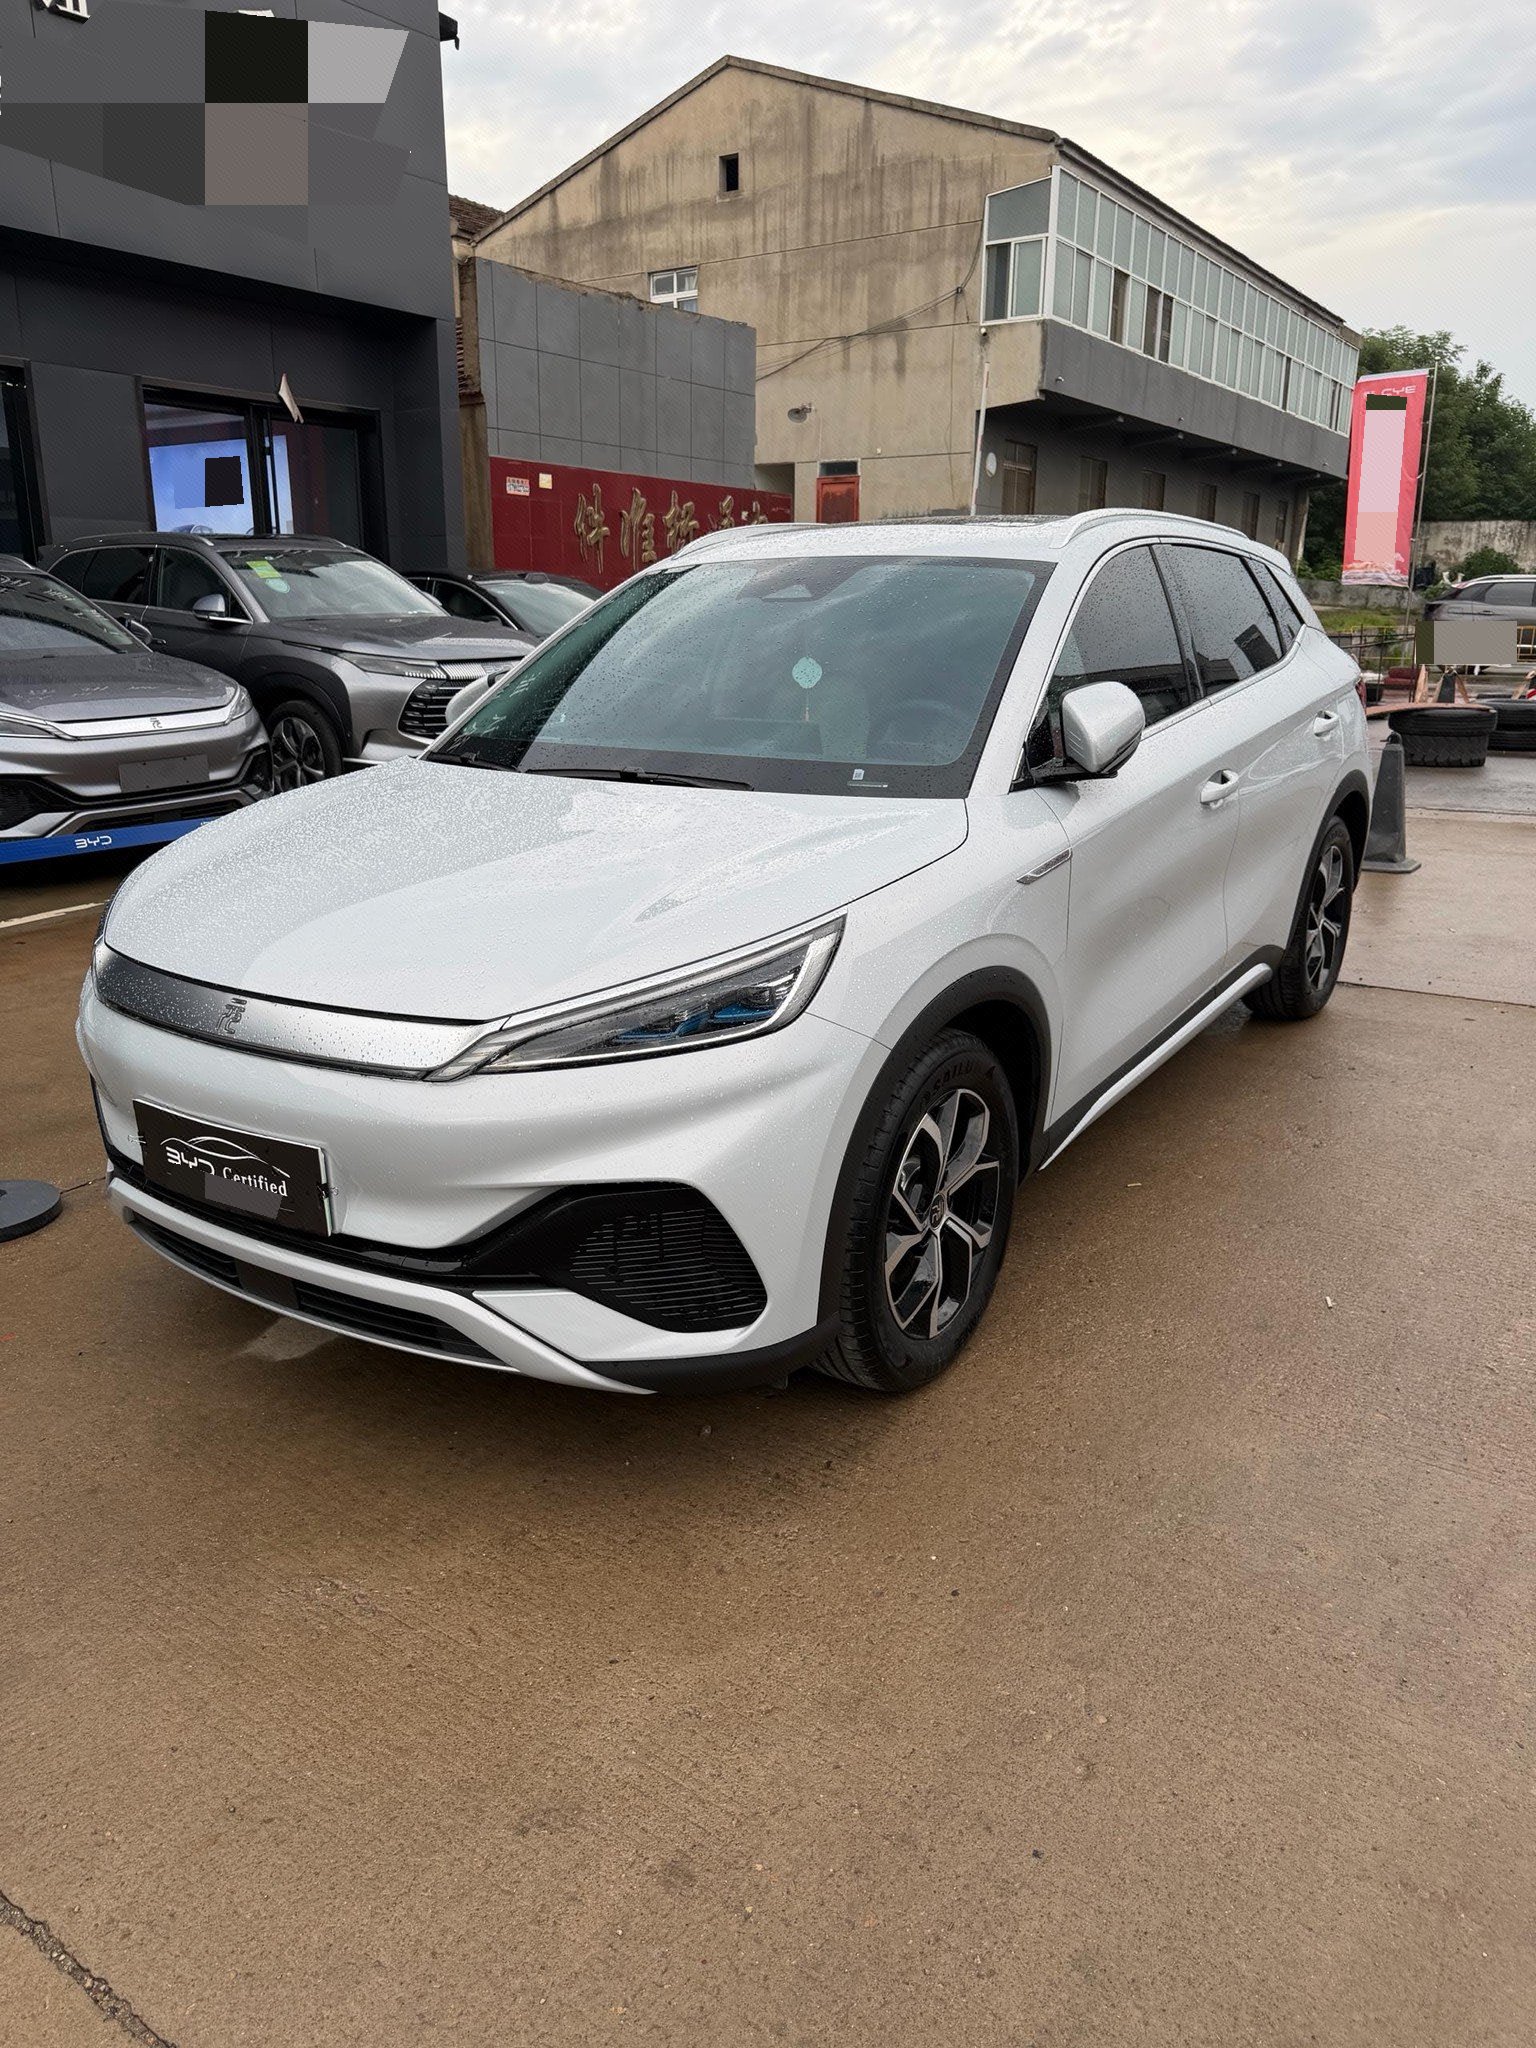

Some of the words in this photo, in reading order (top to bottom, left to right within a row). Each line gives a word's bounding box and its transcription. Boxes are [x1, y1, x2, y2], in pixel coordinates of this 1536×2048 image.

[74, 835, 113, 849] BYD
[166, 1147, 215, 1175] BYD
[222, 1166, 288, 1198] Certified
